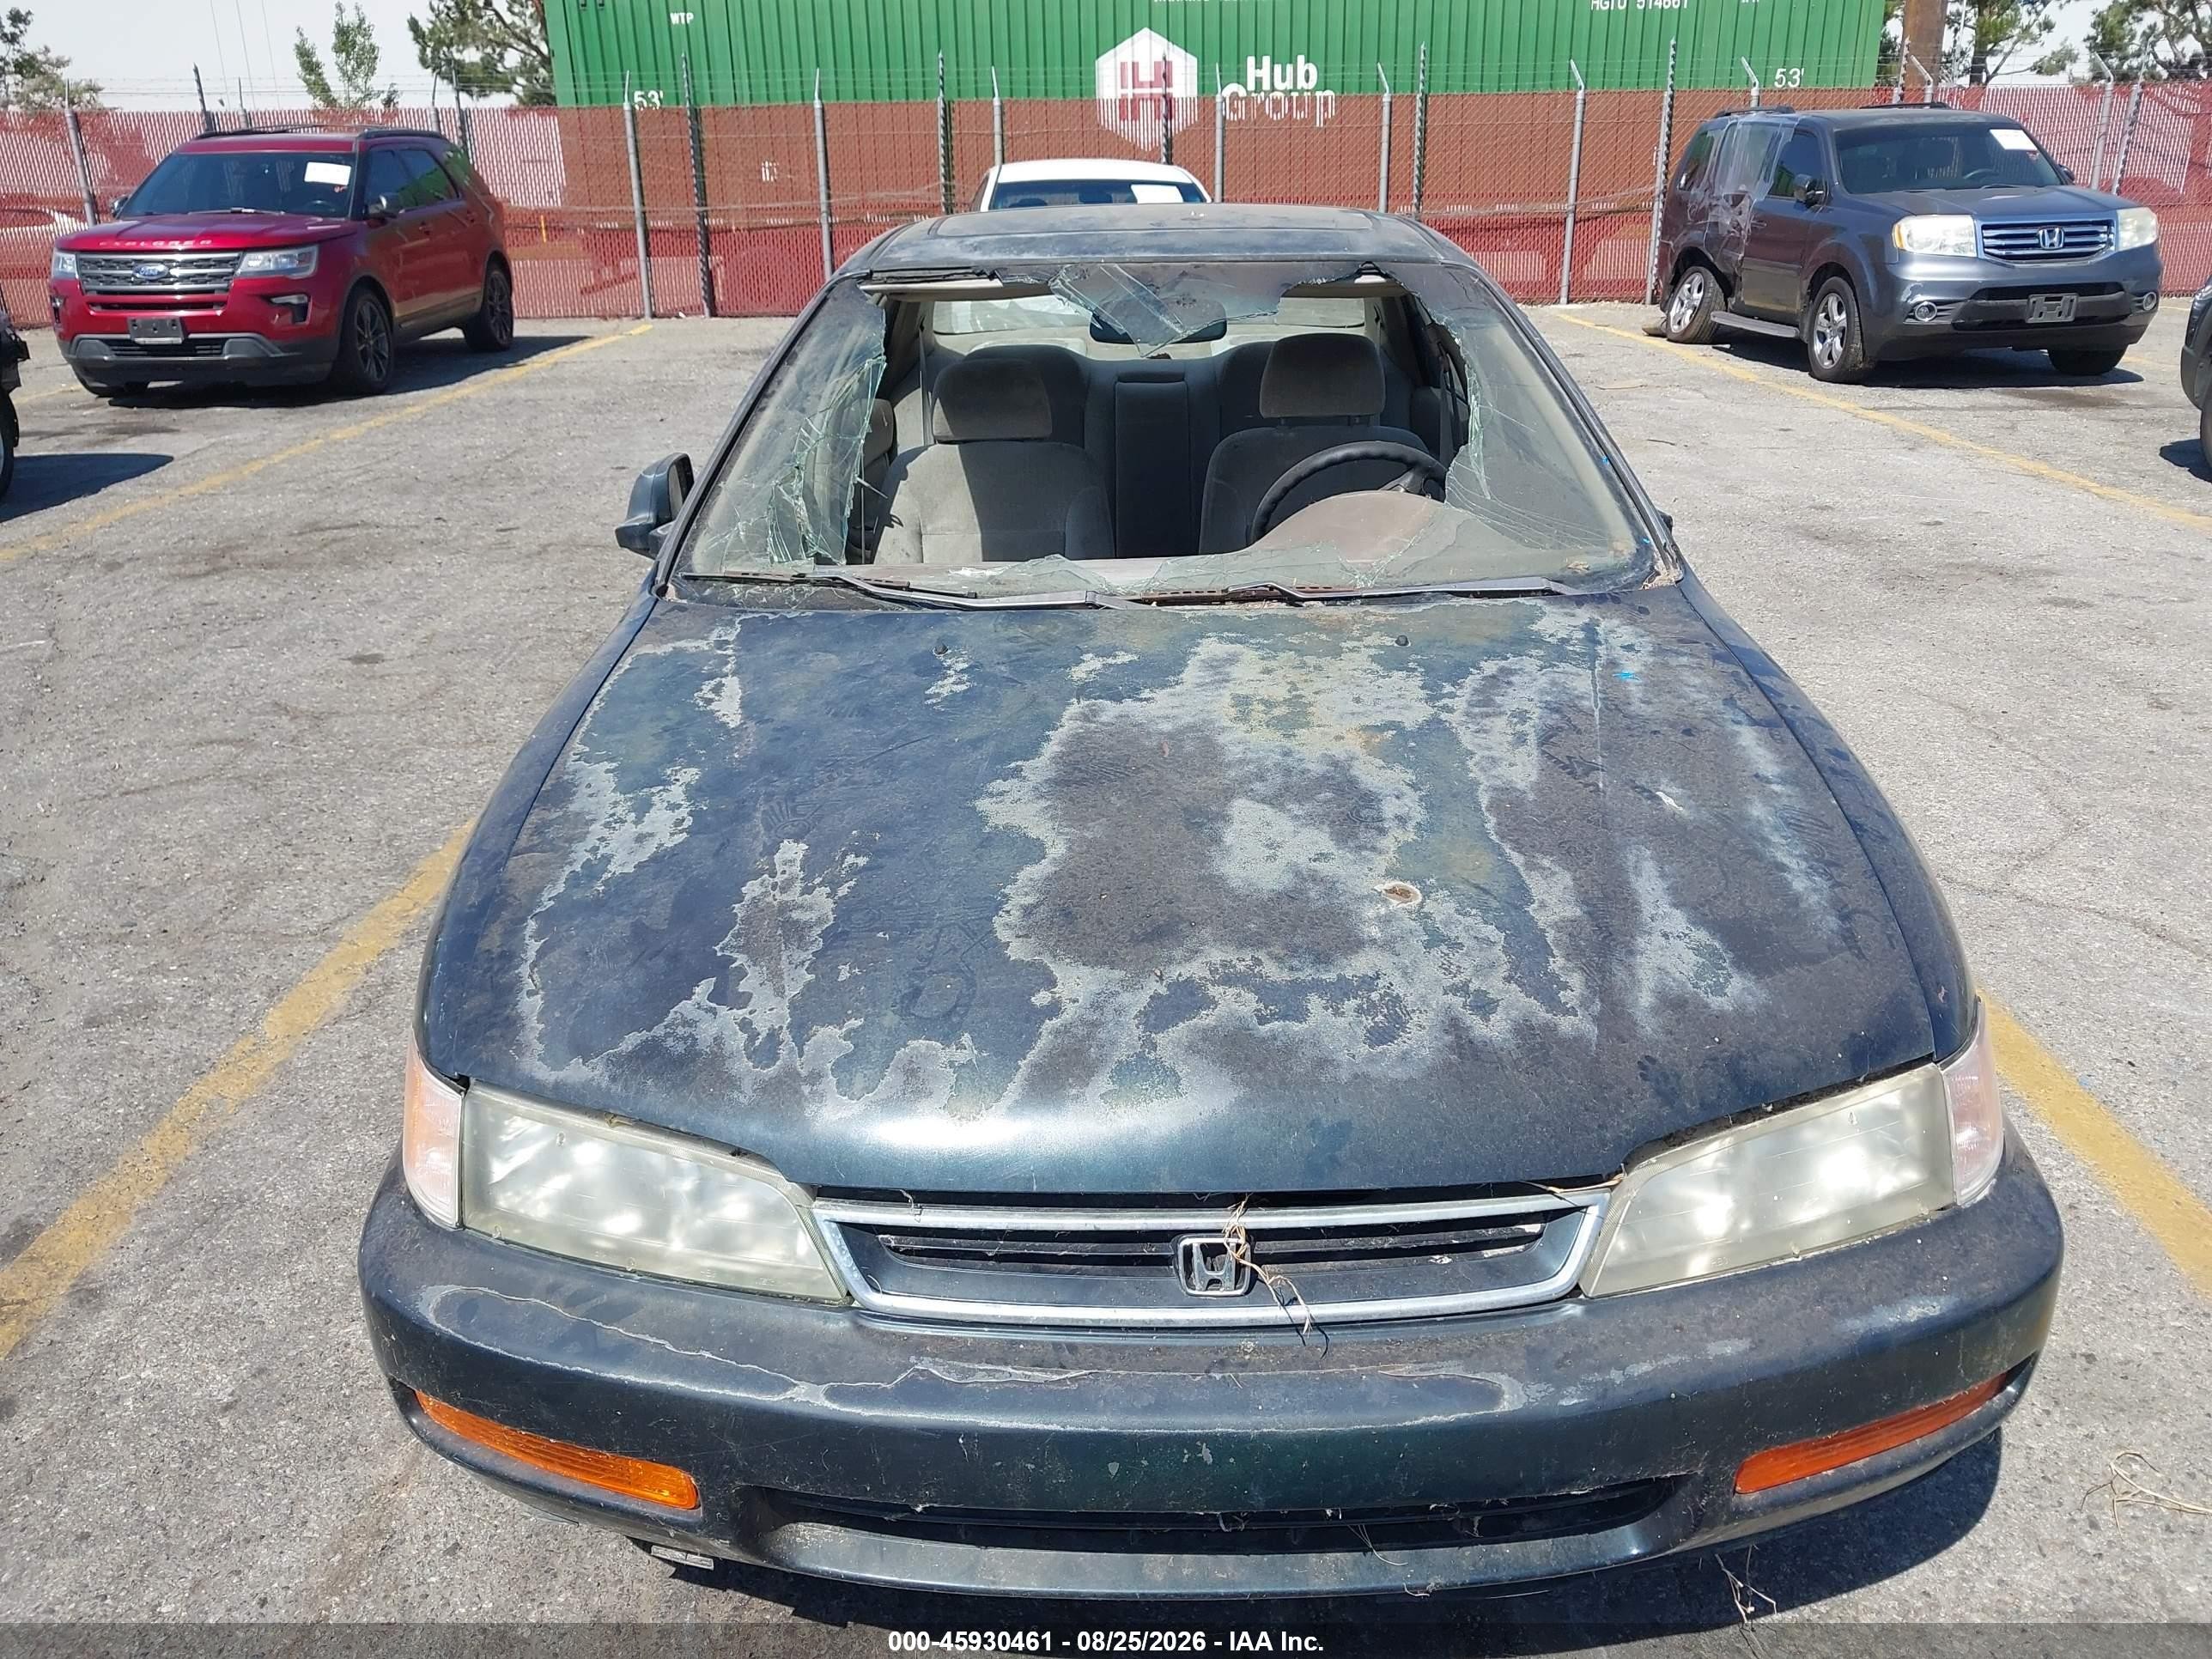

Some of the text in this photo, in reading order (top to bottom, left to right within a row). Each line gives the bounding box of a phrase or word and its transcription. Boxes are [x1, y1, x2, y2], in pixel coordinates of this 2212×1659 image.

[670, 12, 694, 24] WTP
[1247, 55, 1318, 91] Hub
[1221, 82, 1335, 128] Group
